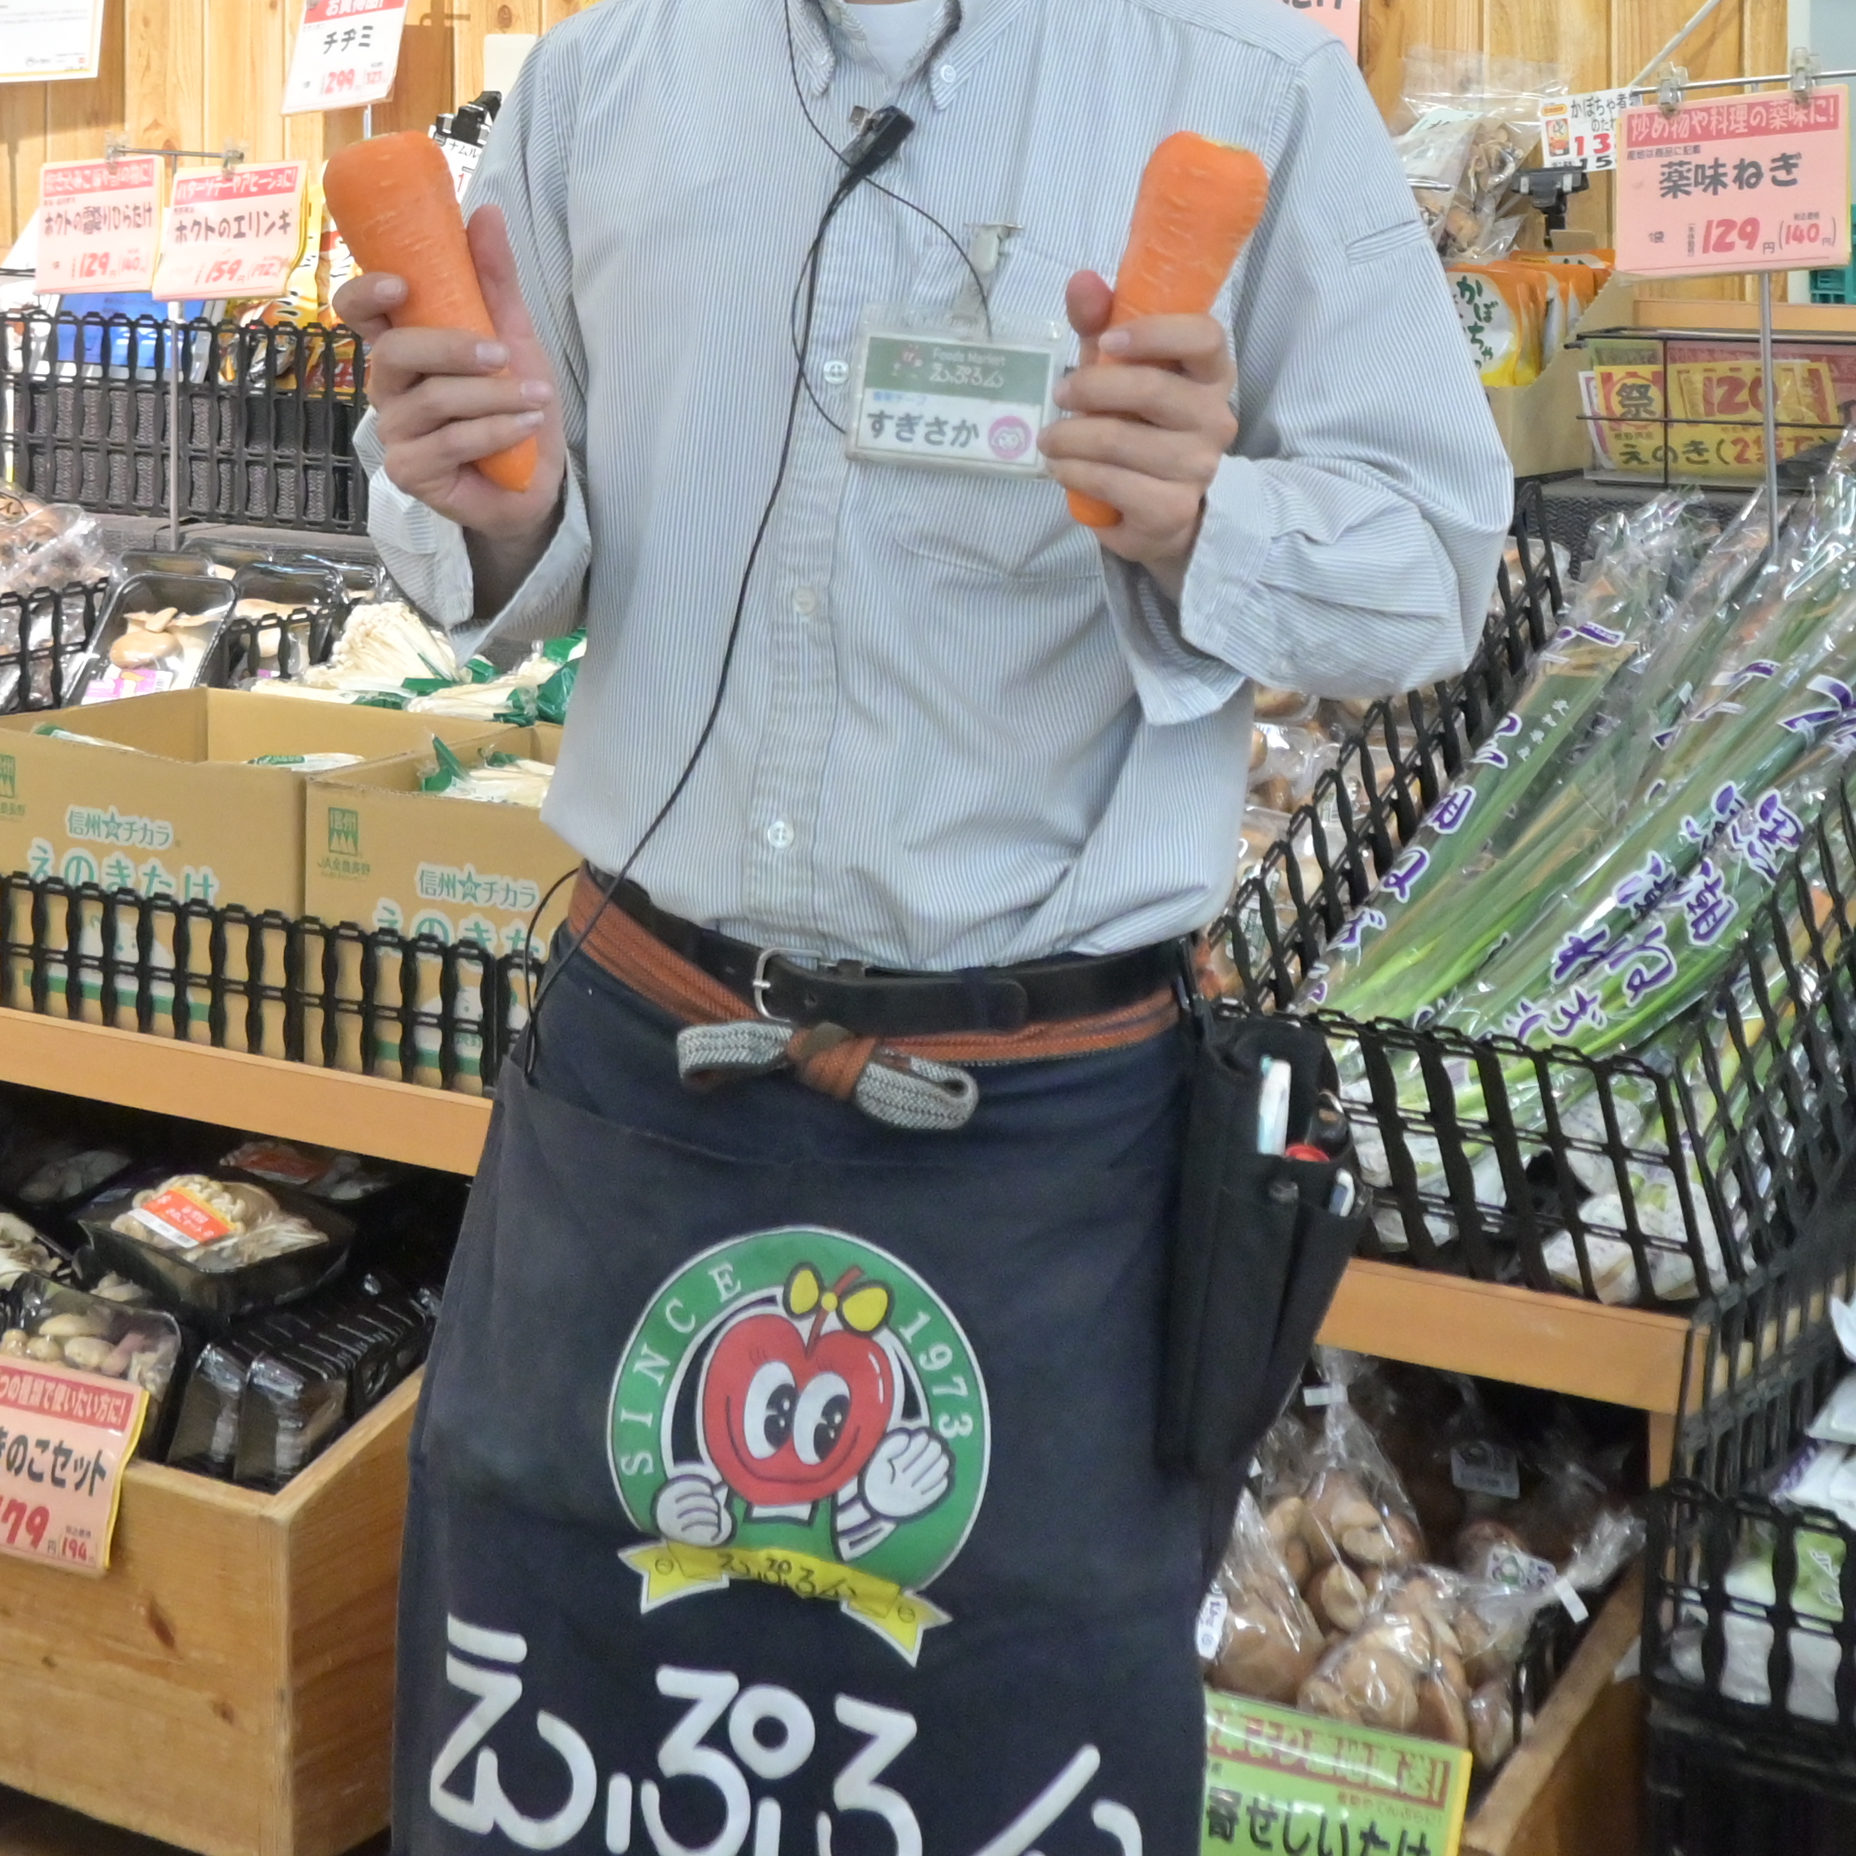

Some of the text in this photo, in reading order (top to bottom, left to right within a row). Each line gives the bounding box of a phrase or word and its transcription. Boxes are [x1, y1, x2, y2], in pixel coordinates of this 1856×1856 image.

[323, 25, 374, 55] チヂミ
[325, 68, 356, 95] 299
[1631, 98, 1835, 142] 炒め物や料理の薬味に!
[1575, 133, 1617, 157] 13
[1627, 145, 1701, 160] 産地は商品に記載
[1580, 155, 1616, 171] 15
[1659, 152, 1803, 199] 薬味ねぎ
[175, 209, 293, 243] ホクトのエリンギ
[1702, 217, 1761, 255] 129
[1785, 223, 1821, 245] 140
[80, 251, 110, 279] 129
[206, 258, 243, 283] 159
[1617, 382, 1660, 420] 祭
[867, 409, 980, 449] すぎさか
[618, 1259, 745, 1479] SINCE
[895, 1306, 974, 1440] 1973
[61, 1536, 89, 1561] 194
